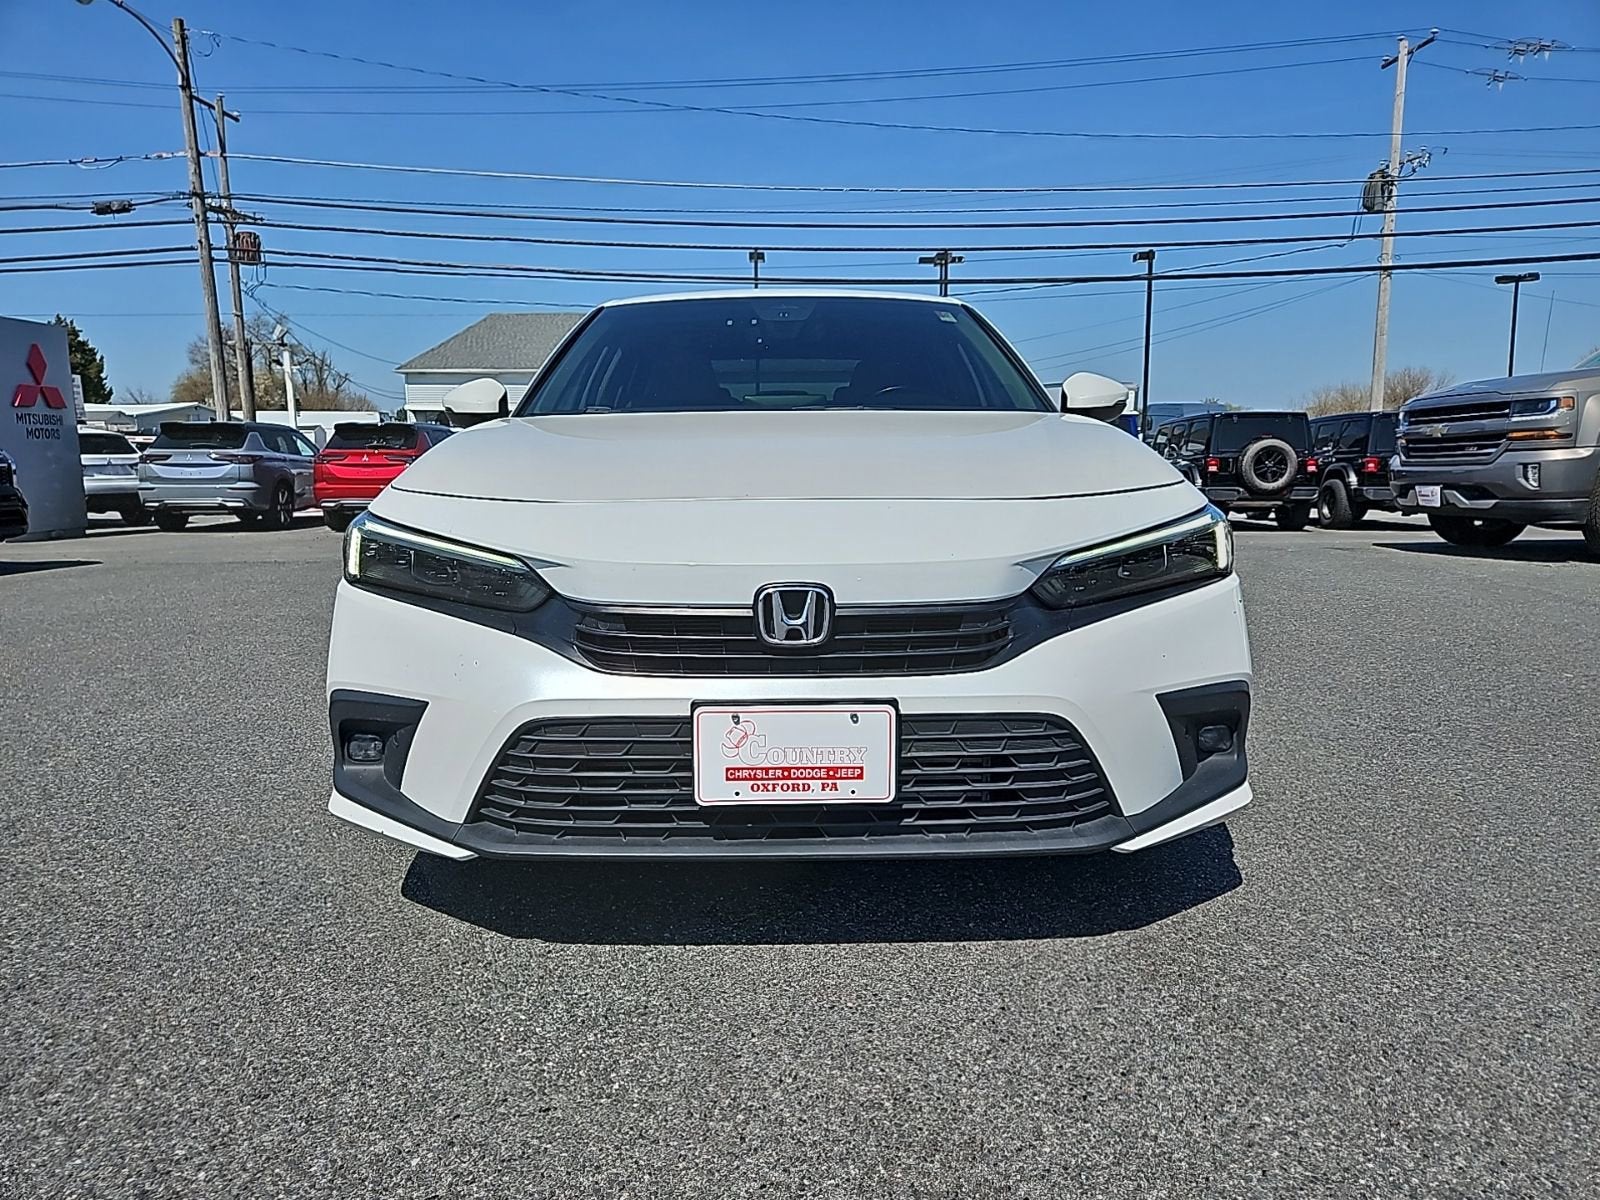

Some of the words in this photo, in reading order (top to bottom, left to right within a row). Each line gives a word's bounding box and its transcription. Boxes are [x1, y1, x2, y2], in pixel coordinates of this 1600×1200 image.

[15, 412, 64, 426] MITSUBISHI
[26, 427, 61, 440] MOTORS
[727, 769, 783, 779] CHRYSLER
[790, 768, 828, 779] DODGE
[834, 768, 861, 778] JEEP
[750, 782, 815, 793] OXFORD,
[820, 782, 839, 792] PA
